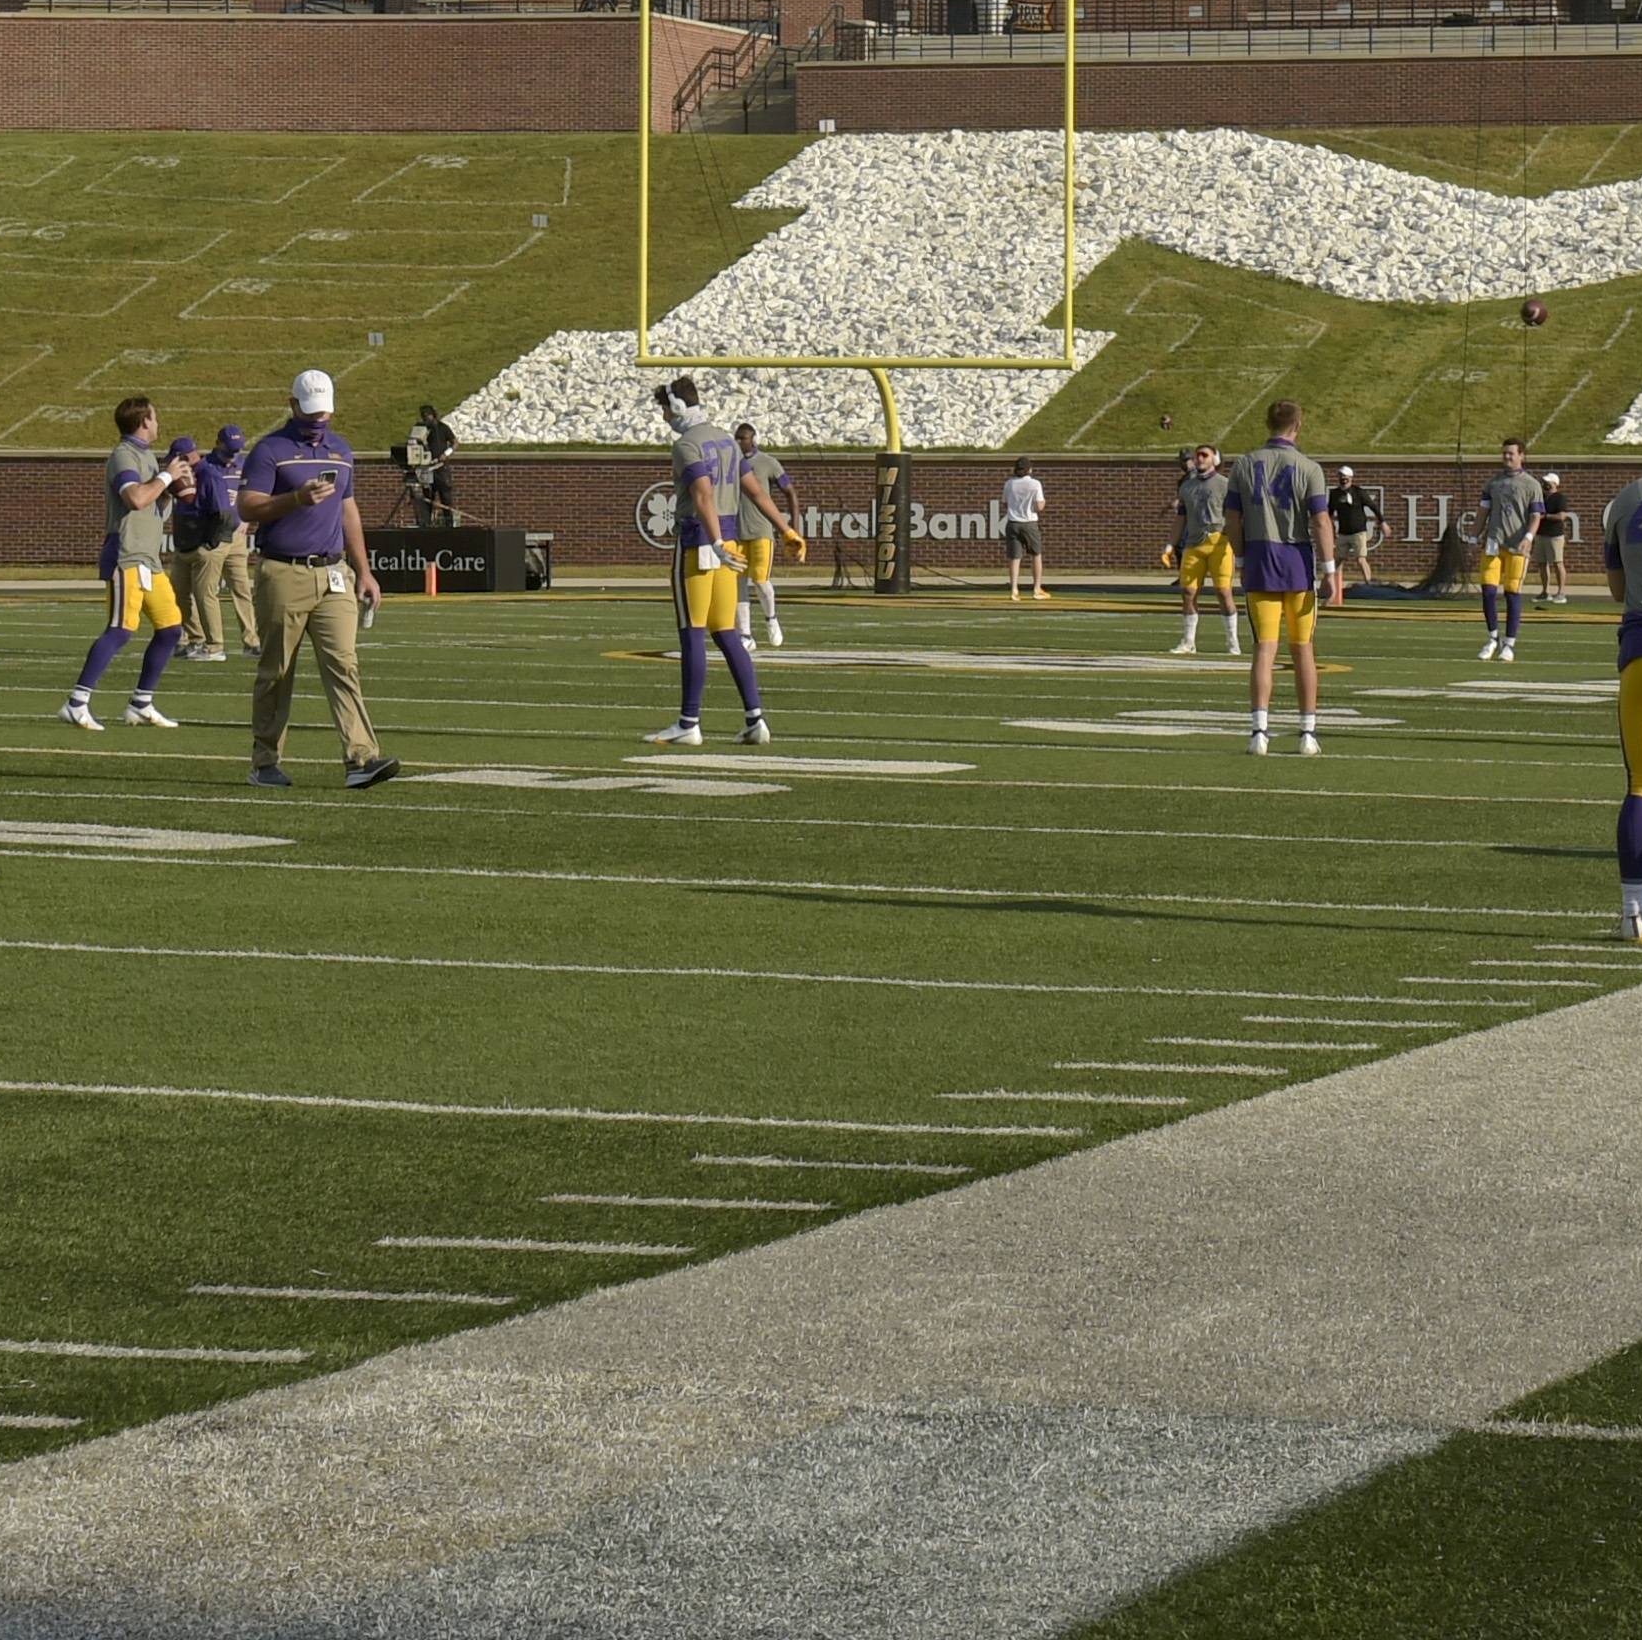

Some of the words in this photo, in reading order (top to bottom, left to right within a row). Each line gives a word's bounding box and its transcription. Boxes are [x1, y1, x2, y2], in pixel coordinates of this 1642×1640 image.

[1251, 460, 1296, 510] 14
[876, 467, 899, 580] MIZZOU
[368, 548, 426, 571] Health
[435, 549, 485, 571] Care
